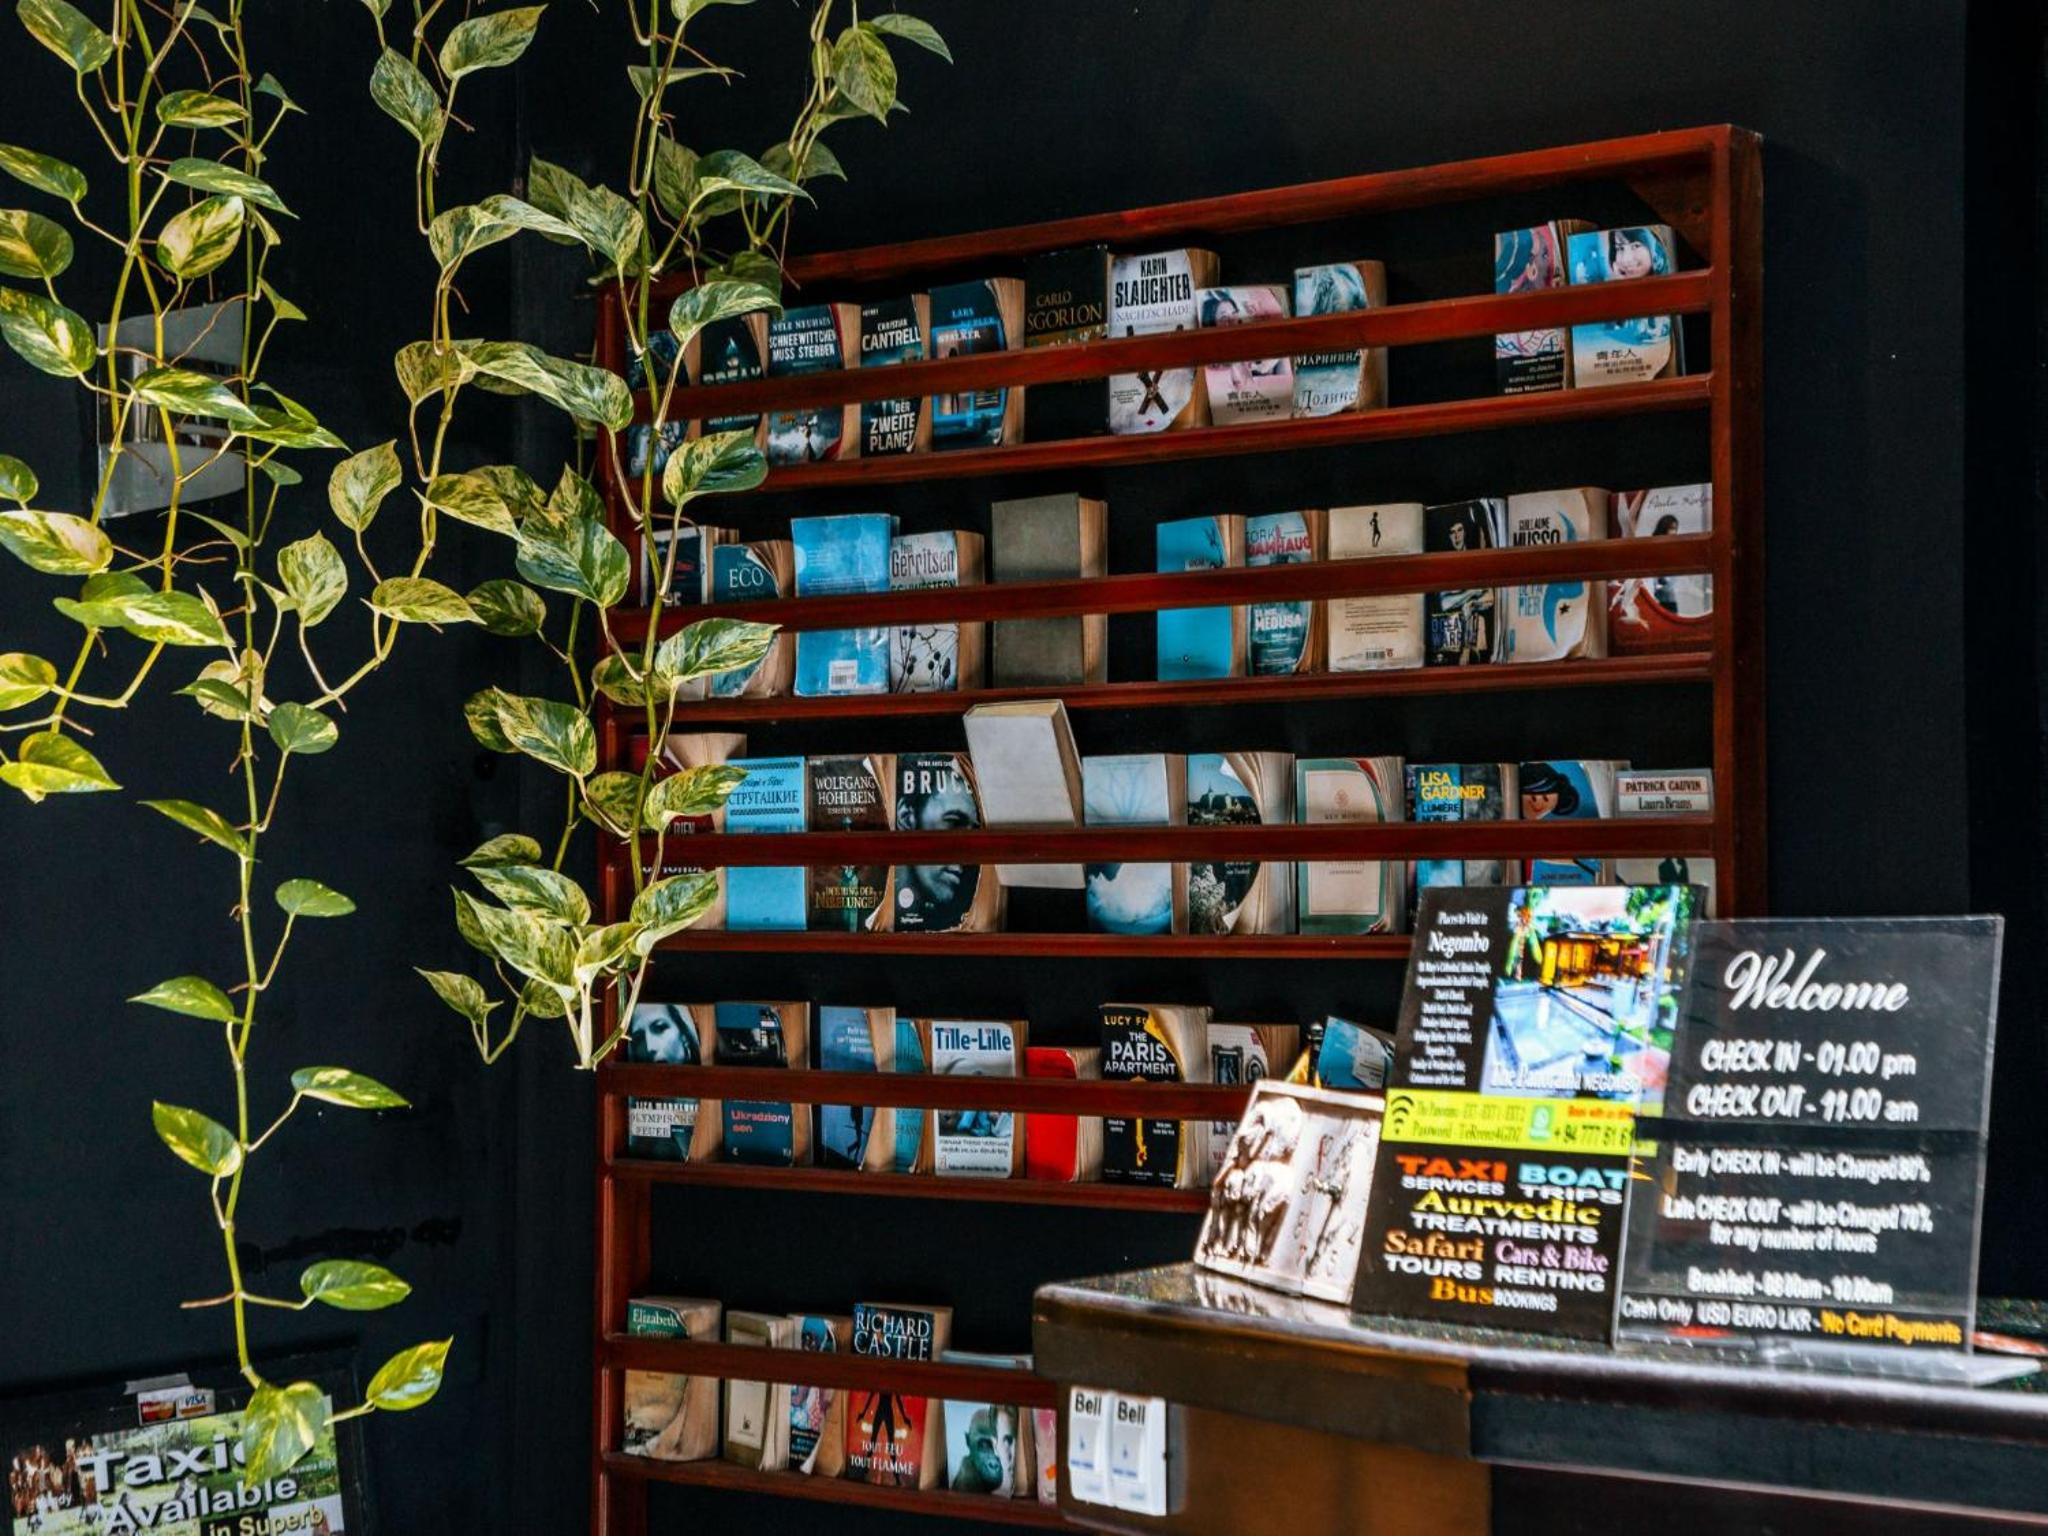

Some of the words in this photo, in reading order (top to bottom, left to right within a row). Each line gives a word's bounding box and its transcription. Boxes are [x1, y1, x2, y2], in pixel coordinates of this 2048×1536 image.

[1140, 256, 1168, 276] KARIN
[1115, 273, 1192, 308] SLAUGHTER
[769, 328, 836, 349] SCHNEEWITTCHEN
[862, 326, 921, 351] CANTRELL
[772, 347, 795, 361] MUSS
[798, 343, 835, 359] STERBEN
[870, 412, 916, 435] ZWEITE
[870, 430, 915, 452] PLANET
[1513, 529, 1561, 546] MUSSO
[892, 547, 955, 578] Gerritsen
[729, 567, 764, 588] ECO
[1255, 613, 1303, 632] MEDUSA
[815, 776, 876, 790] WOLFGANG
[1420, 771, 1452, 786] LISA
[1625, 780, 1666, 793] PATRICK
[1668, 780, 1702, 792] CAUVIN
[728, 790, 798, 806] СТРУГАЦКИЕ
[817, 791, 876, 805] HOHLBEIN
[1421, 784, 1486, 801] GARDNER
[1428, 931, 1490, 958] Negombo
[1724, 948, 1909, 1012] Welcome
[1104, 1015, 1131, 1026] LUCY
[934, 1027, 1011, 1051] Tille-Lille
[1128, 1031, 1147, 1042] THE
[1111, 1041, 1167, 1062] PARIS
[1701, 1039, 1773, 1073] CHECK
[1775, 1040, 1801, 1072] IN
[1817, 1040, 1880, 1076] 01.00
[1881, 1053, 1916, 1080] pm
[1104, 1061, 1176, 1075] APARTMENT
[1687, 1083, 1760, 1117] CHECK
[1761, 1084, 1806, 1118] OUT
[1819, 1087, 1882, 1122] 11.00
[1884, 1100, 1919, 1122] am
[731, 1110, 790, 1126] Ukradziony
[1396, 1154, 1508, 1182] TAXI
[1518, 1163, 1629, 1190] BOAT
[1673, 1147, 1710, 1177] Early
[1711, 1149, 1762, 1176] CHECK
[1763, 1151, 1780, 1176] IN
[1788, 1152, 1815, 1177] will
[1816, 1153, 1836, 1178] be
[1837, 1154, 1898, 1185] Charged
[1401, 1175, 1505, 1196] SERVICES
[1518, 1184, 1623, 1205] TRIPS
[1414, 1189, 1602, 1226] Aurvedic
[1663, 1195, 1695, 1221] Late
[1696, 1196, 1748, 1223] CHECK
[1749, 1199, 1781, 1223] OUT
[1789, 1201, 1815, 1226] will
[1816, 1203, 1837, 1227] be
[1837, 1202, 1899, 1234] Charged
[1410, 1211, 1599, 1245] TREATMENTS
[1709, 1222, 1731, 1245] for
[1732, 1227, 1761, 1252] any
[1762, 1227, 1815, 1251] number
[1816, 1227, 1834, 1251] of
[1834, 1229, 1878, 1253] hours
[1384, 1229, 1485, 1261] Safari
[1495, 1239, 1539, 1266] Cars
[1542, 1244, 1561, 1269] &
[1563, 1245, 1609, 1273] Bike
[1383, 1253, 1483, 1280] TOURS
[1493, 1264, 1606, 1292] RENTING
[1429, 1278, 1493, 1305] Bus
[1494, 1288, 1558, 1312] BOOKINGS
[633, 1308, 678, 1328] Elizabeth
[854, 1312, 931, 1338] RICHARD
[1621, 1297, 1656, 1319] Cash
[1658, 1298, 1693, 1325] Only
[1697, 1300, 1730, 1325] USD
[1731, 1303, 1777, 1329] EURO
[1778, 1306, 1811, 1332] LKR
[1820, 1309, 1844, 1334] No
[1845, 1312, 1883, 1336] Card
[1884, 1314, 1962, 1345] Payments
[854, 1331, 930, 1361] CASTLE
[185, 1395, 207, 1406] VISA
[1074, 1391, 1102, 1417] Bell
[1117, 1402, 1147, 1426] Bell
[860, 1440, 883, 1452] TOUT
[885, 1442, 904, 1455] FEU
[851, 1456, 872, 1468] TOUT
[873, 1457, 914, 1476] FLAMME
[103, 1477, 298, 1535] Available
[238, 1504, 324, 1536] Superb
